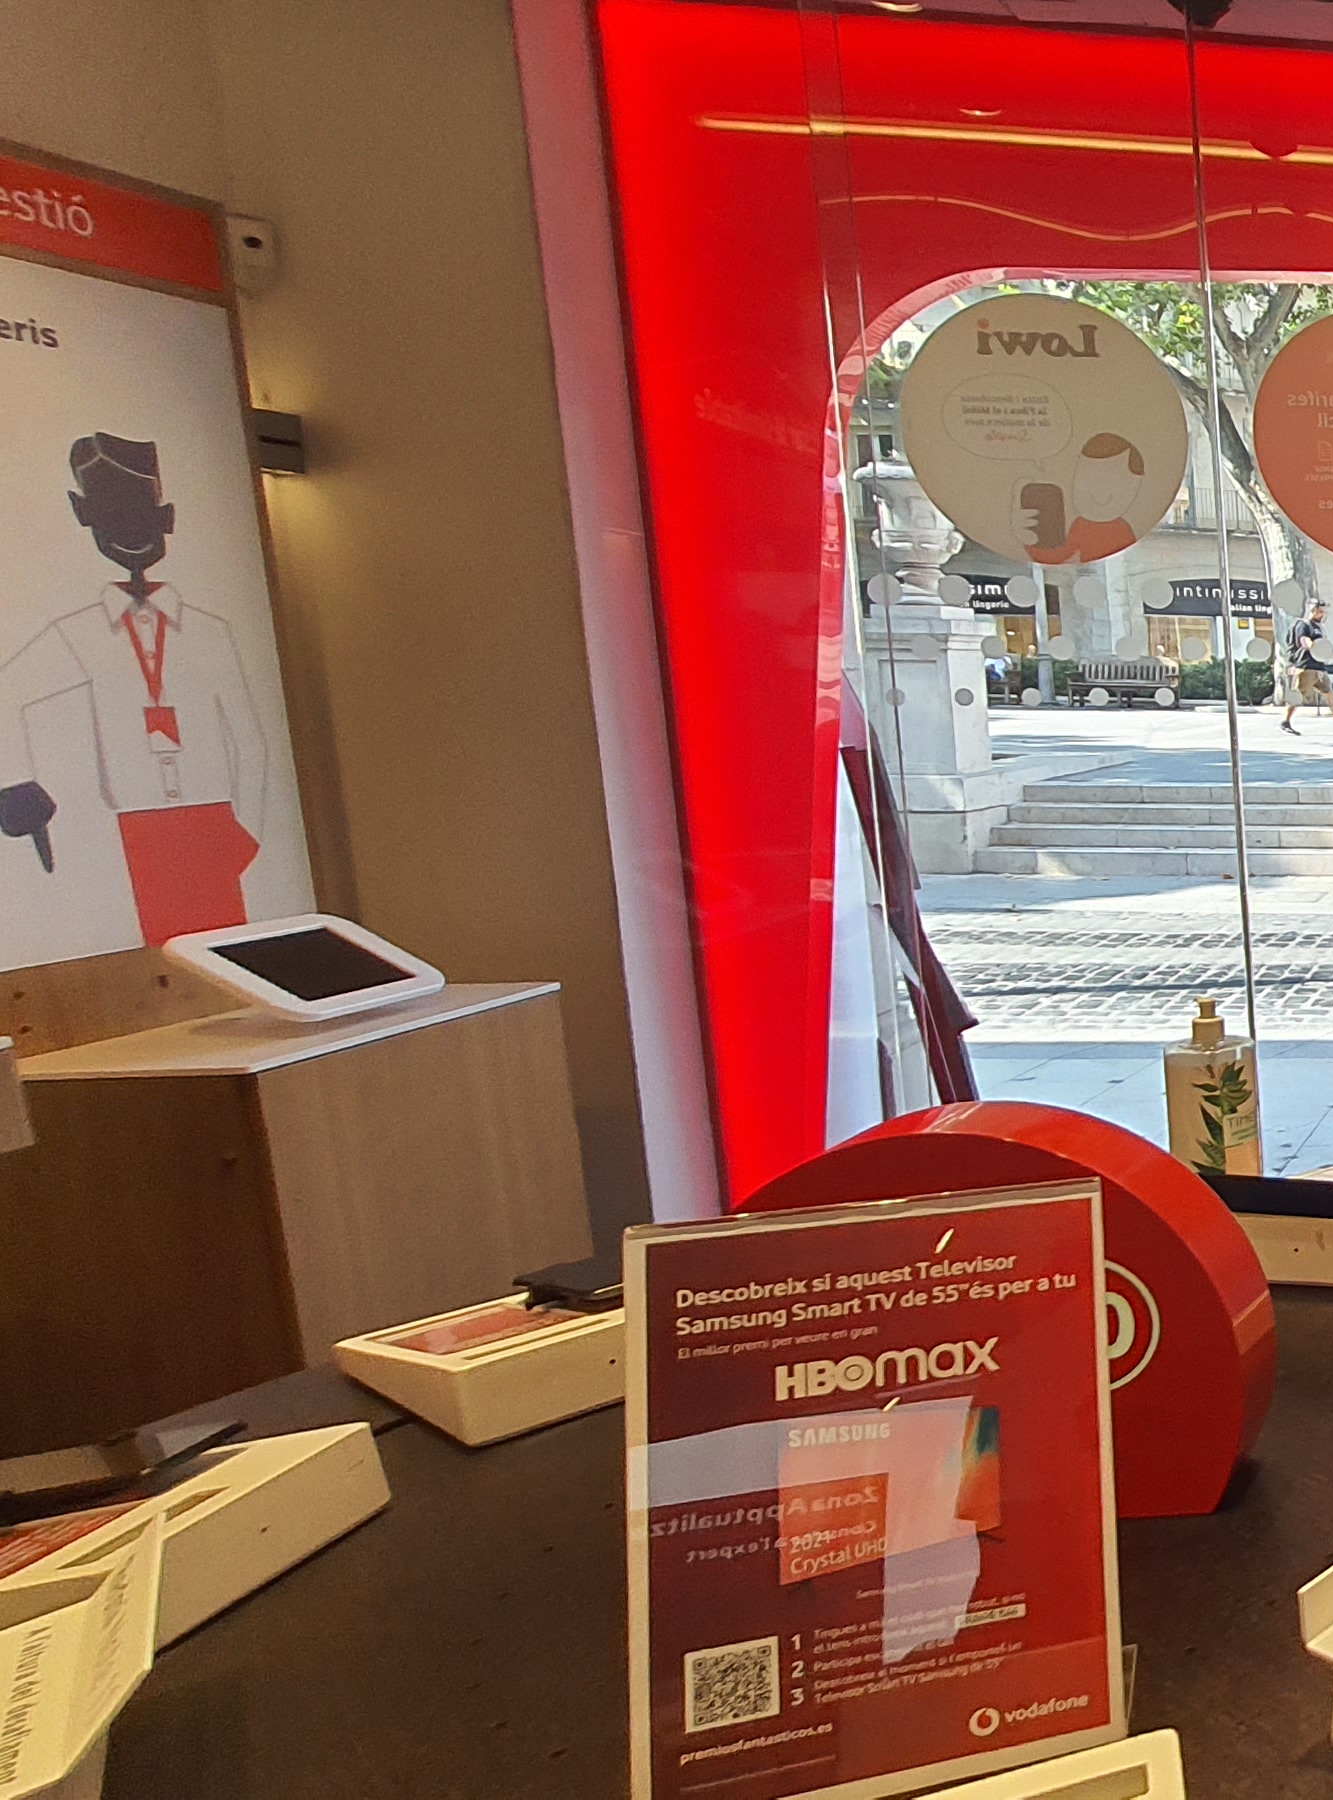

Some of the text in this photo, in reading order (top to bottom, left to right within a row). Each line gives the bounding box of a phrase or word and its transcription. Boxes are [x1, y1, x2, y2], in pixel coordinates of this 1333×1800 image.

[676, 1253, 1018, 1309] Descobreix si aquest Televisor
[675, 1305, 787, 1336] Samsung
[791, 1298, 862, 1322] Smart
[865, 1293, 898, 1315] TV
[900, 1288, 928, 1308] de
[998, 1278, 1034, 1301] per
[1037, 1278, 1050, 1292] a
[1054, 1272, 1077, 1289] tu
[678, 1346, 692, 1360] El
[693, 1341, 731, 1359] millor
[733, 1338, 769, 1357] premi
[772, 1335, 794, 1351] per
[788, 1421, 892, 1448] SAMSUNG
[790, 1547, 852, 1576] Crystal
[790, 1633, 801, 1651] 1
[791, 1660, 805, 1679] 2
[790, 1688, 805, 1706] 3
[1005, 1693, 1089, 1724] vodafone
